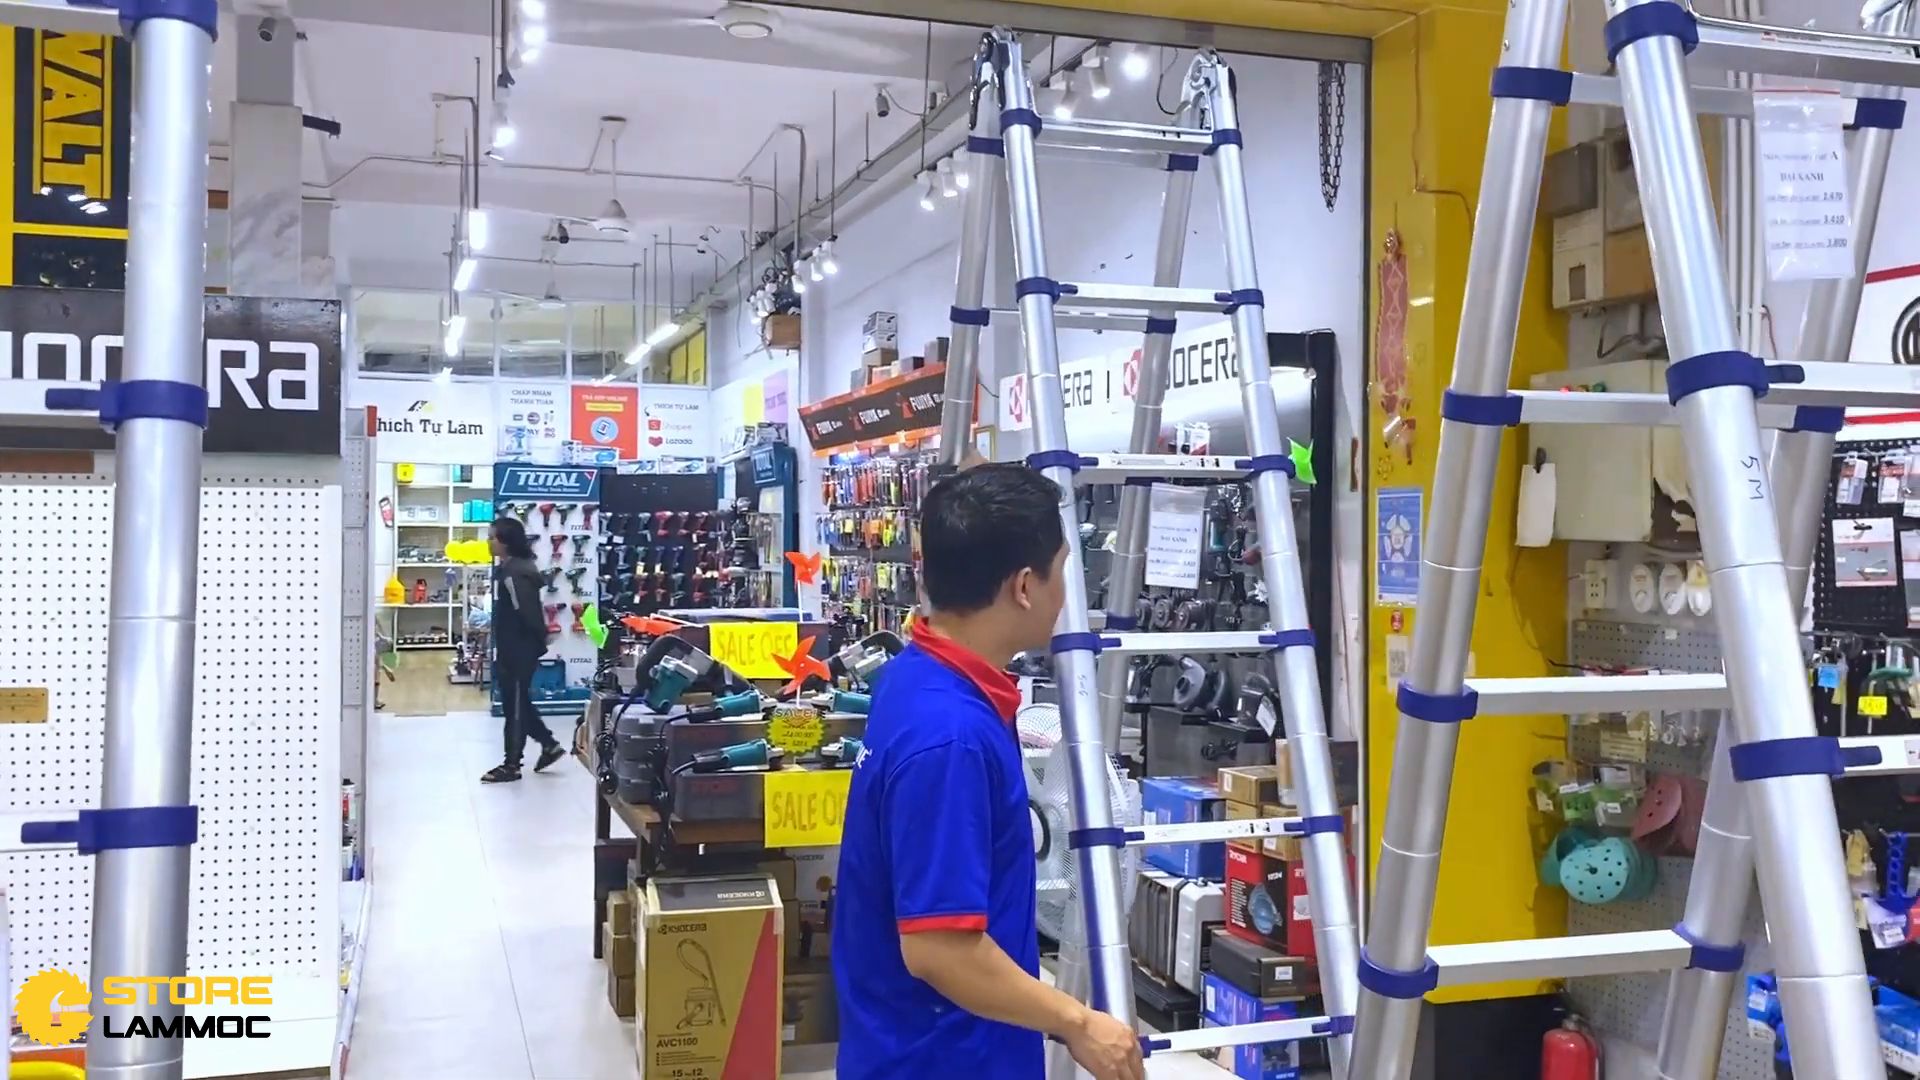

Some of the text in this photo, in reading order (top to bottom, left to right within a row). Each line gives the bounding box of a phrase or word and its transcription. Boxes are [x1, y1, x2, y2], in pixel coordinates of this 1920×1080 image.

[42, 29, 103, 199] WALT
[516, 471, 580, 487] TOTAL
[716, 632, 756, 665] SALE
[771, 791, 818, 832] SALE
